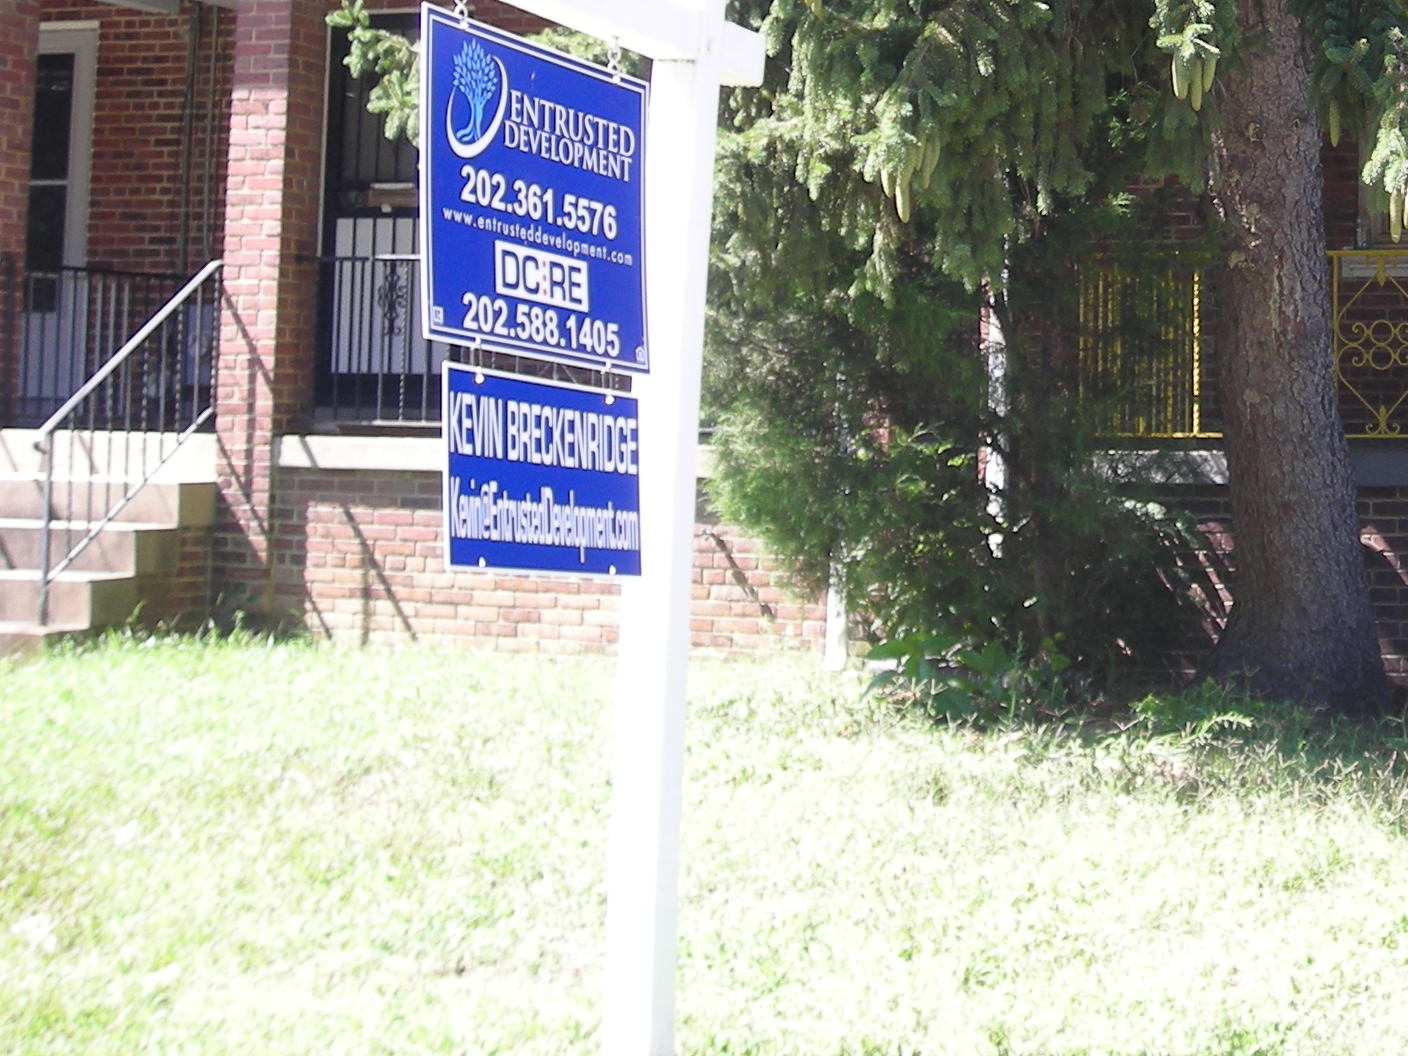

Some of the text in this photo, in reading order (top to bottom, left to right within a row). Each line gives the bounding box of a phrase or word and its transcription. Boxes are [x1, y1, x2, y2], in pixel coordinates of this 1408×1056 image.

[504, 120, 632, 182] DEVELOPMENT
[510, 90, 635, 157] ENTRUSTED
[460, 165, 617, 240] 202.361.5576
[443, 207, 632, 265] www.entrusteddevelopment.com
[462, 293, 620, 357] 202.588.1405
[450, 392, 637, 475] KEVIN BRECKENRIDGE
